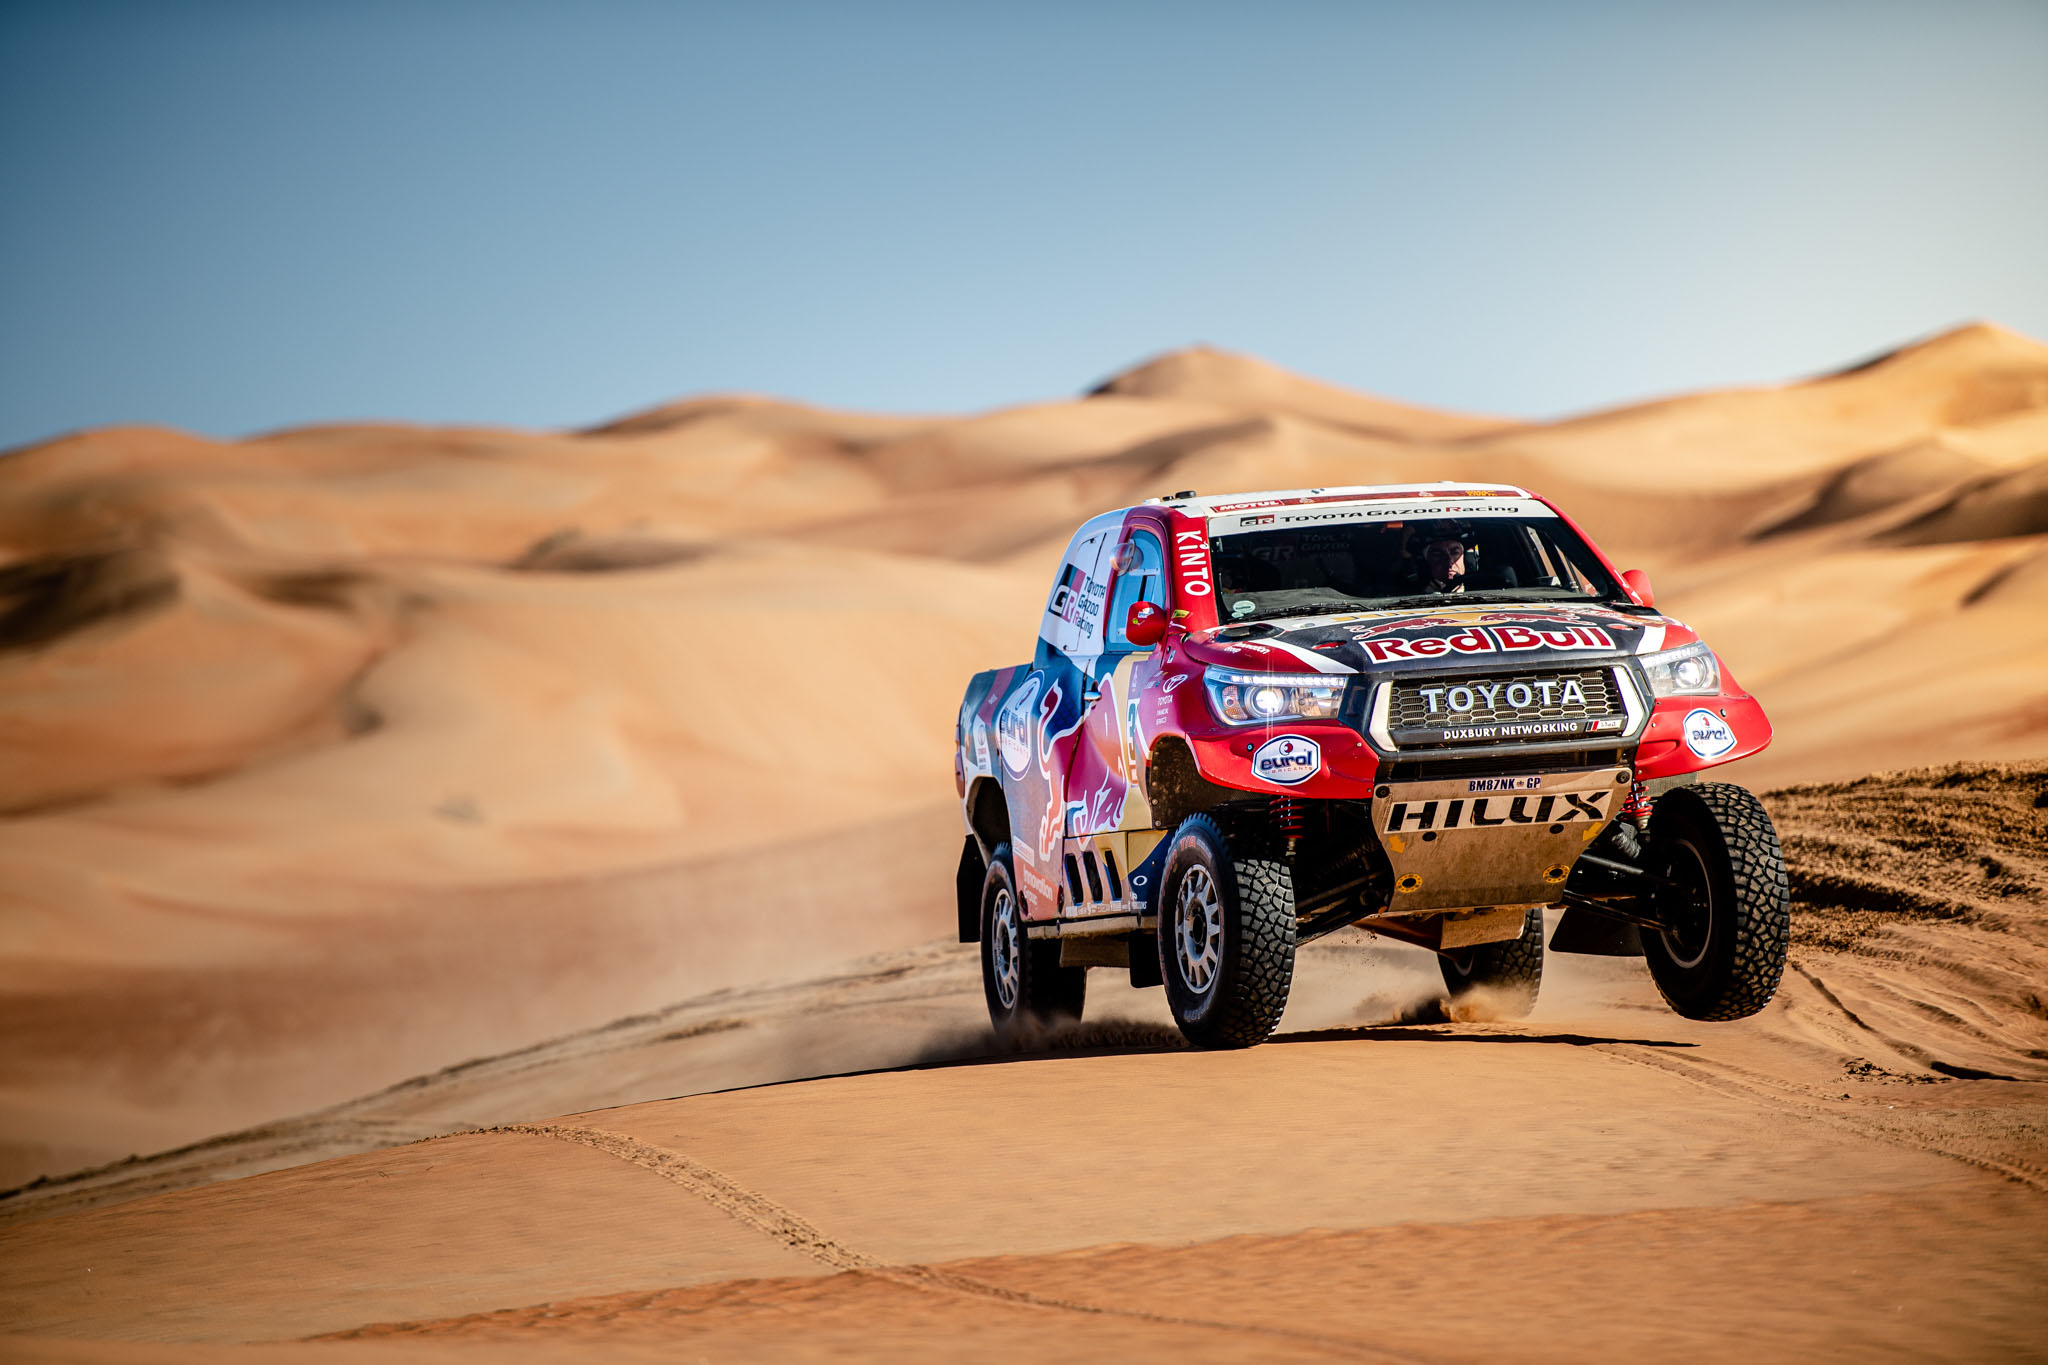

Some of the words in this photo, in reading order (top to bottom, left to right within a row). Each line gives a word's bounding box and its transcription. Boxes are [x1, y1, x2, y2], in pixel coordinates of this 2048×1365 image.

[1218, 500, 1280, 511] MOTUL
[1241, 516, 1275, 527] GR
[1084, 576, 1107, 599] TOYOTA
[1049, 584, 1080, 624] GR
[1077, 594, 1100, 617] GAZOO
[1073, 610, 1094, 640] Racing
[1360, 627, 1497, 664] Red
[1490, 625, 1617, 652] Bull
[1419, 679, 1588, 714] TOYOTA
[1443, 727, 1497, 740] DUXBURY
[1501, 722, 1578, 736] NETWORKING
[1260, 750, 1313, 771] eurol
[1262, 766, 1313, 775] UBRICANTS
[1469, 778, 1516, 792] BM87NK
[1526, 777, 1541, 789] GP
[1387, 791, 1610, 832] HILUX
